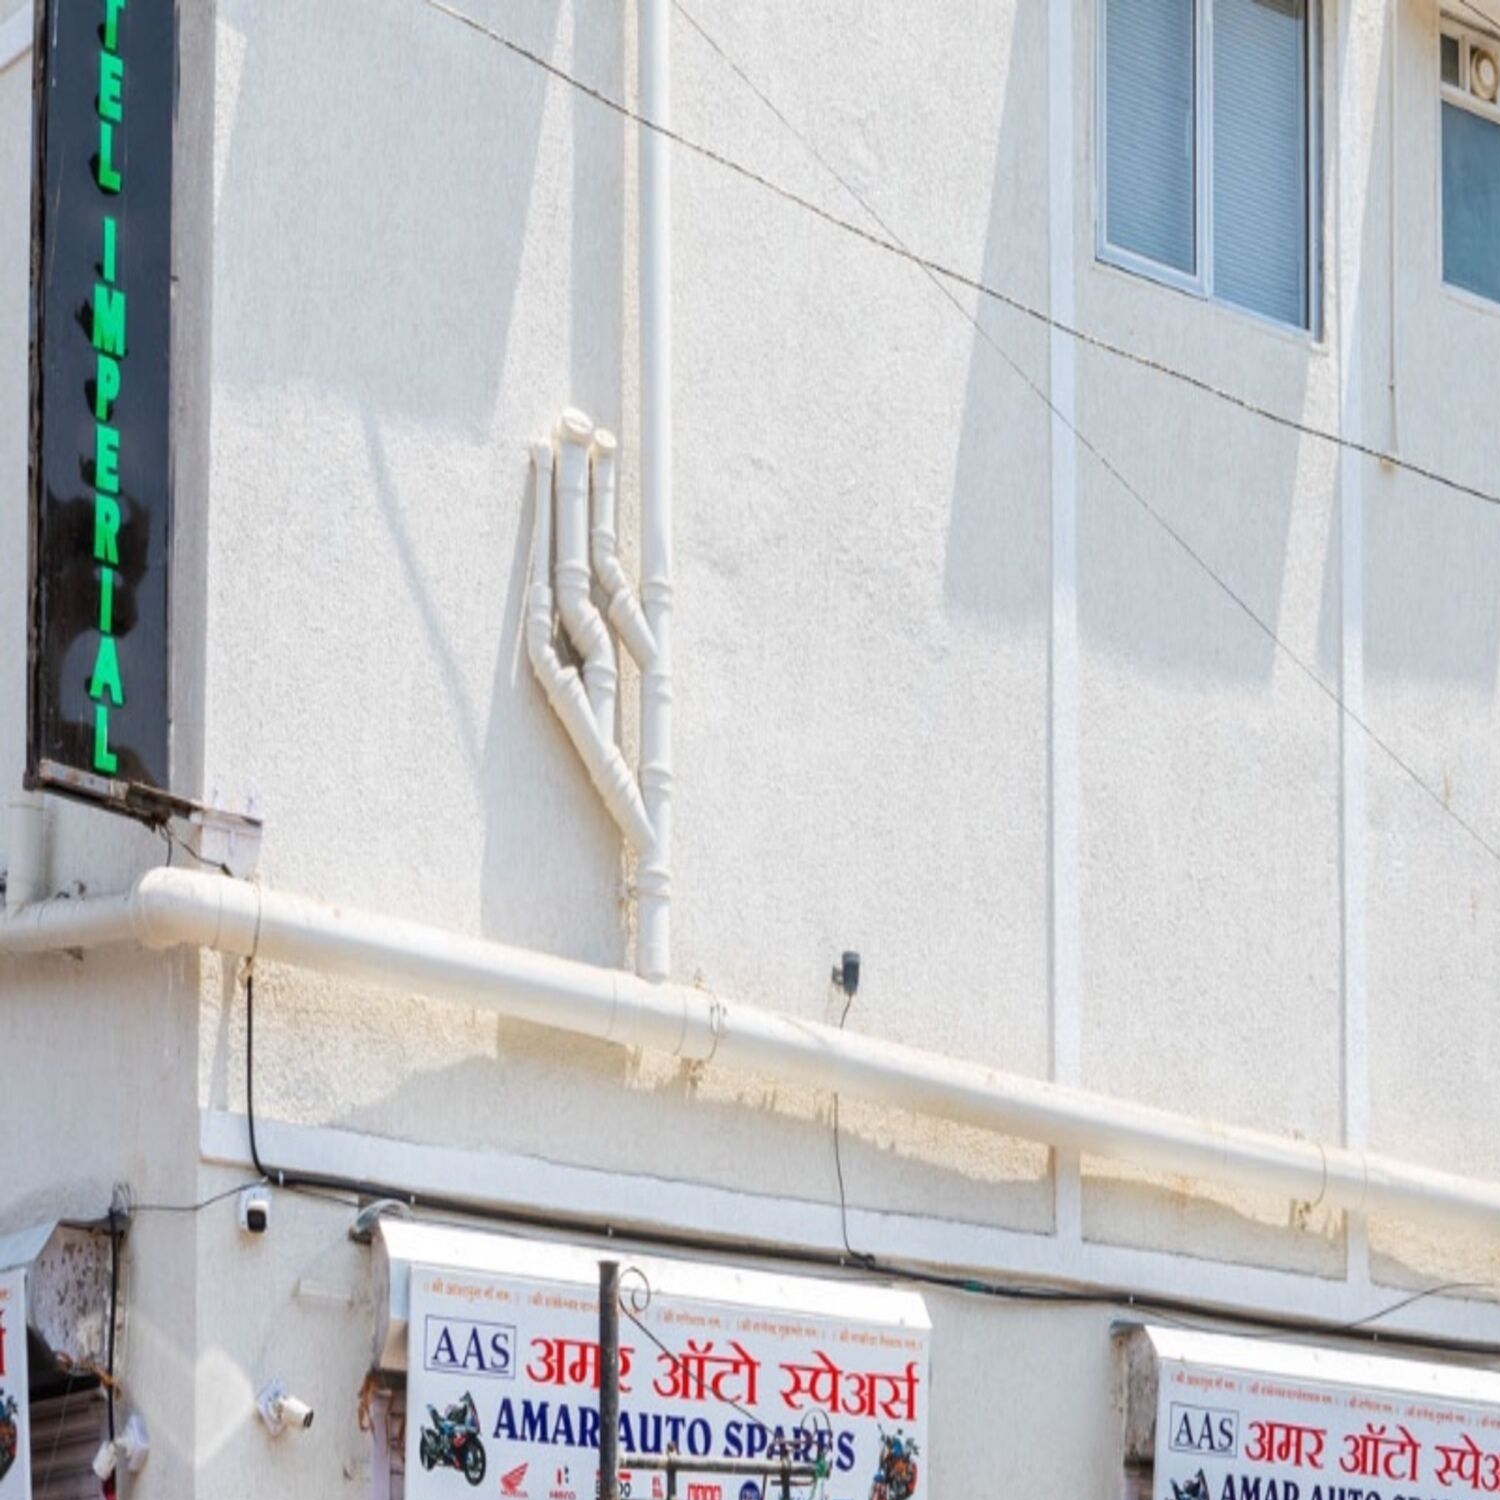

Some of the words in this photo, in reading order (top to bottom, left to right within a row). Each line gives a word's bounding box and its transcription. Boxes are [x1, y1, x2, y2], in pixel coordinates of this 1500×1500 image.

[90, 216, 126, 774] IMPERIAL
[431, 1325, 511, 1373] AAS
[526, 1337, 635, 1392] अमर
[653, 1338, 761, 1406] ऑटो
[779, 1350, 920, 1421] स्पेअर्स
[492, 1396, 601, 1449] AMAR
[616, 1409, 712, 1457] AUTO
[723, 1419, 856, 1472] SPARES
[1173, 1411, 1234, 1452] AAS
[1244, 1420, 1327, 1470] अमर
[1339, 1422, 1422, 1482] ऑटो
